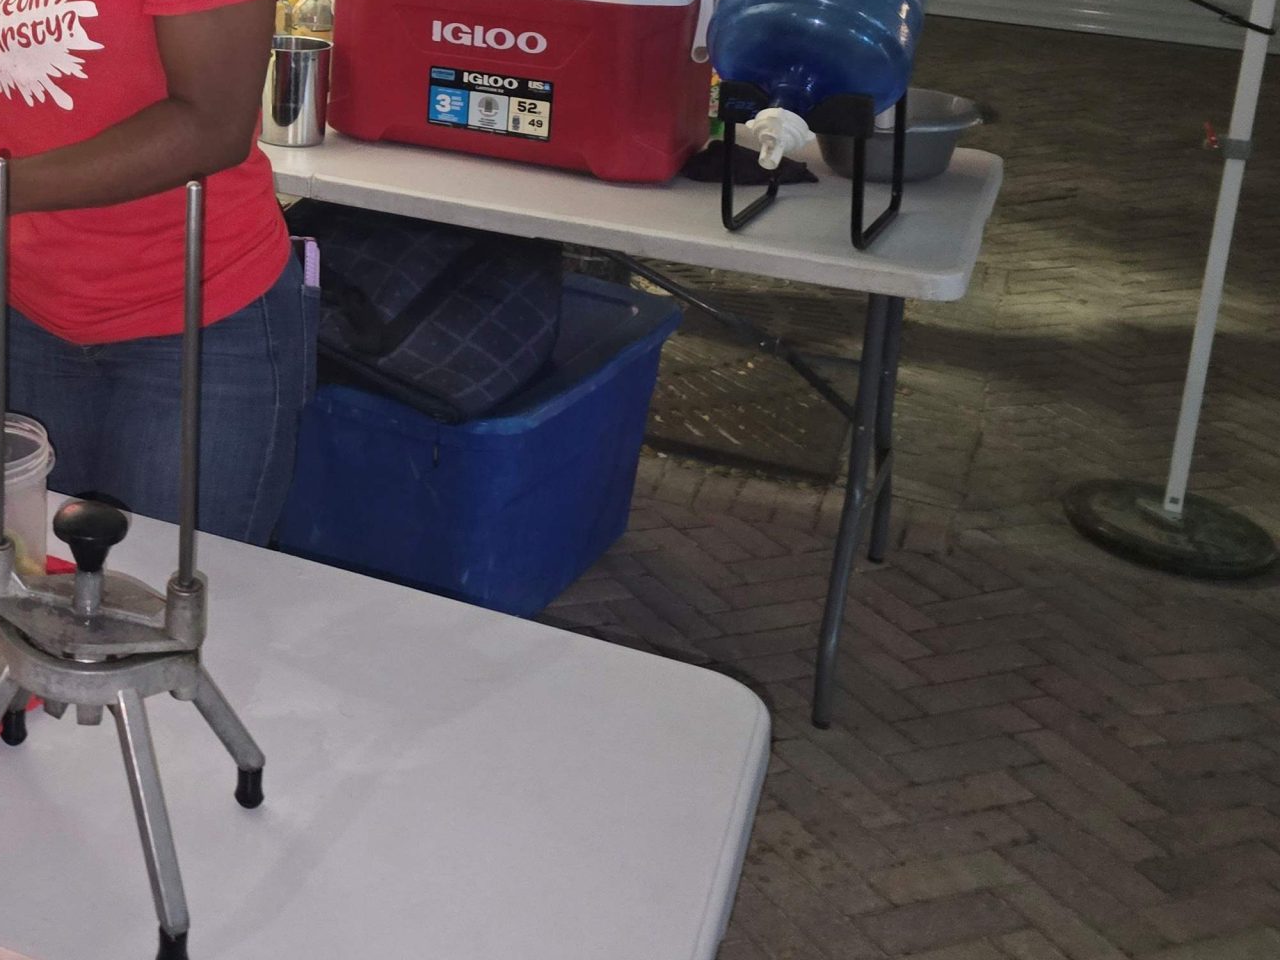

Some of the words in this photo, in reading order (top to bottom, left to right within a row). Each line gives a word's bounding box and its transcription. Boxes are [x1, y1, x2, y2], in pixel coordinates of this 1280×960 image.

[431, 20, 548, 54] IGLOO
[462, 71, 519, 90] IGLOO
[435, 93, 451, 113] 3
[517, 100, 538, 114] 52
[528, 118, 544, 129] 49
